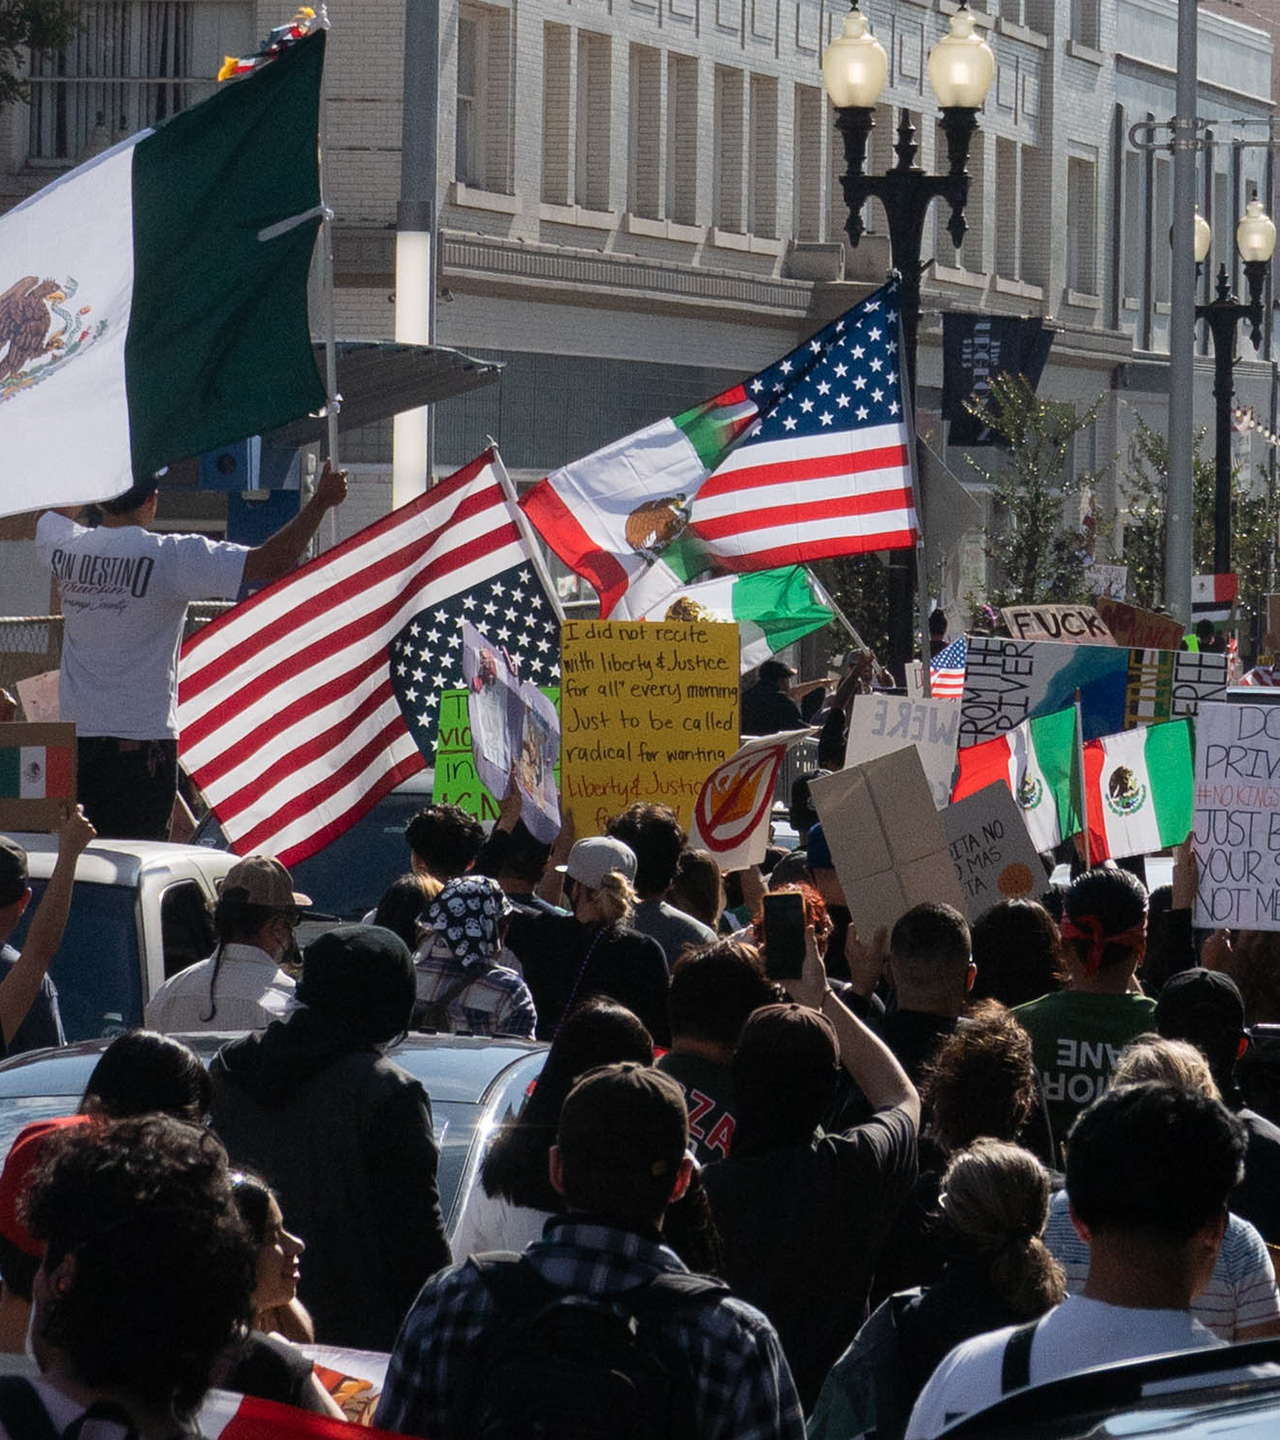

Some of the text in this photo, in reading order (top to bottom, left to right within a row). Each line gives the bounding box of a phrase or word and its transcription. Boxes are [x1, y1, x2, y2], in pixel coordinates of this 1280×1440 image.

[51, 549, 155, 598] SIN DESTINO
[565, 622, 708, 643] I did not recite
[1013, 611, 1107, 640] FUCK
[601, 652, 653, 680] liberty
[656, 652, 666, 673] &
[667, 649, 730, 672] Justice
[963, 637, 1003, 682] THE
[565, 679, 589, 698] for
[630, 683, 682, 703] every
[996, 641, 1035, 732] RIVER
[1172, 651, 1227, 717] FREE
[567, 709, 733, 732] Just to be called
[566, 739, 631, 763] radical
[639, 748, 660, 763] for
[567, 775, 629, 807] Liberty
[645, 770, 703, 796] Justic
[982, 820, 1004, 843] NO
[1195, 809, 1263, 848] JUST
[966, 845, 1002, 873] MAS
[1197, 848, 1264, 884] YOUR
[1197, 888, 1251, 923] NOT
[687, 1089, 737, 1159] ZA
